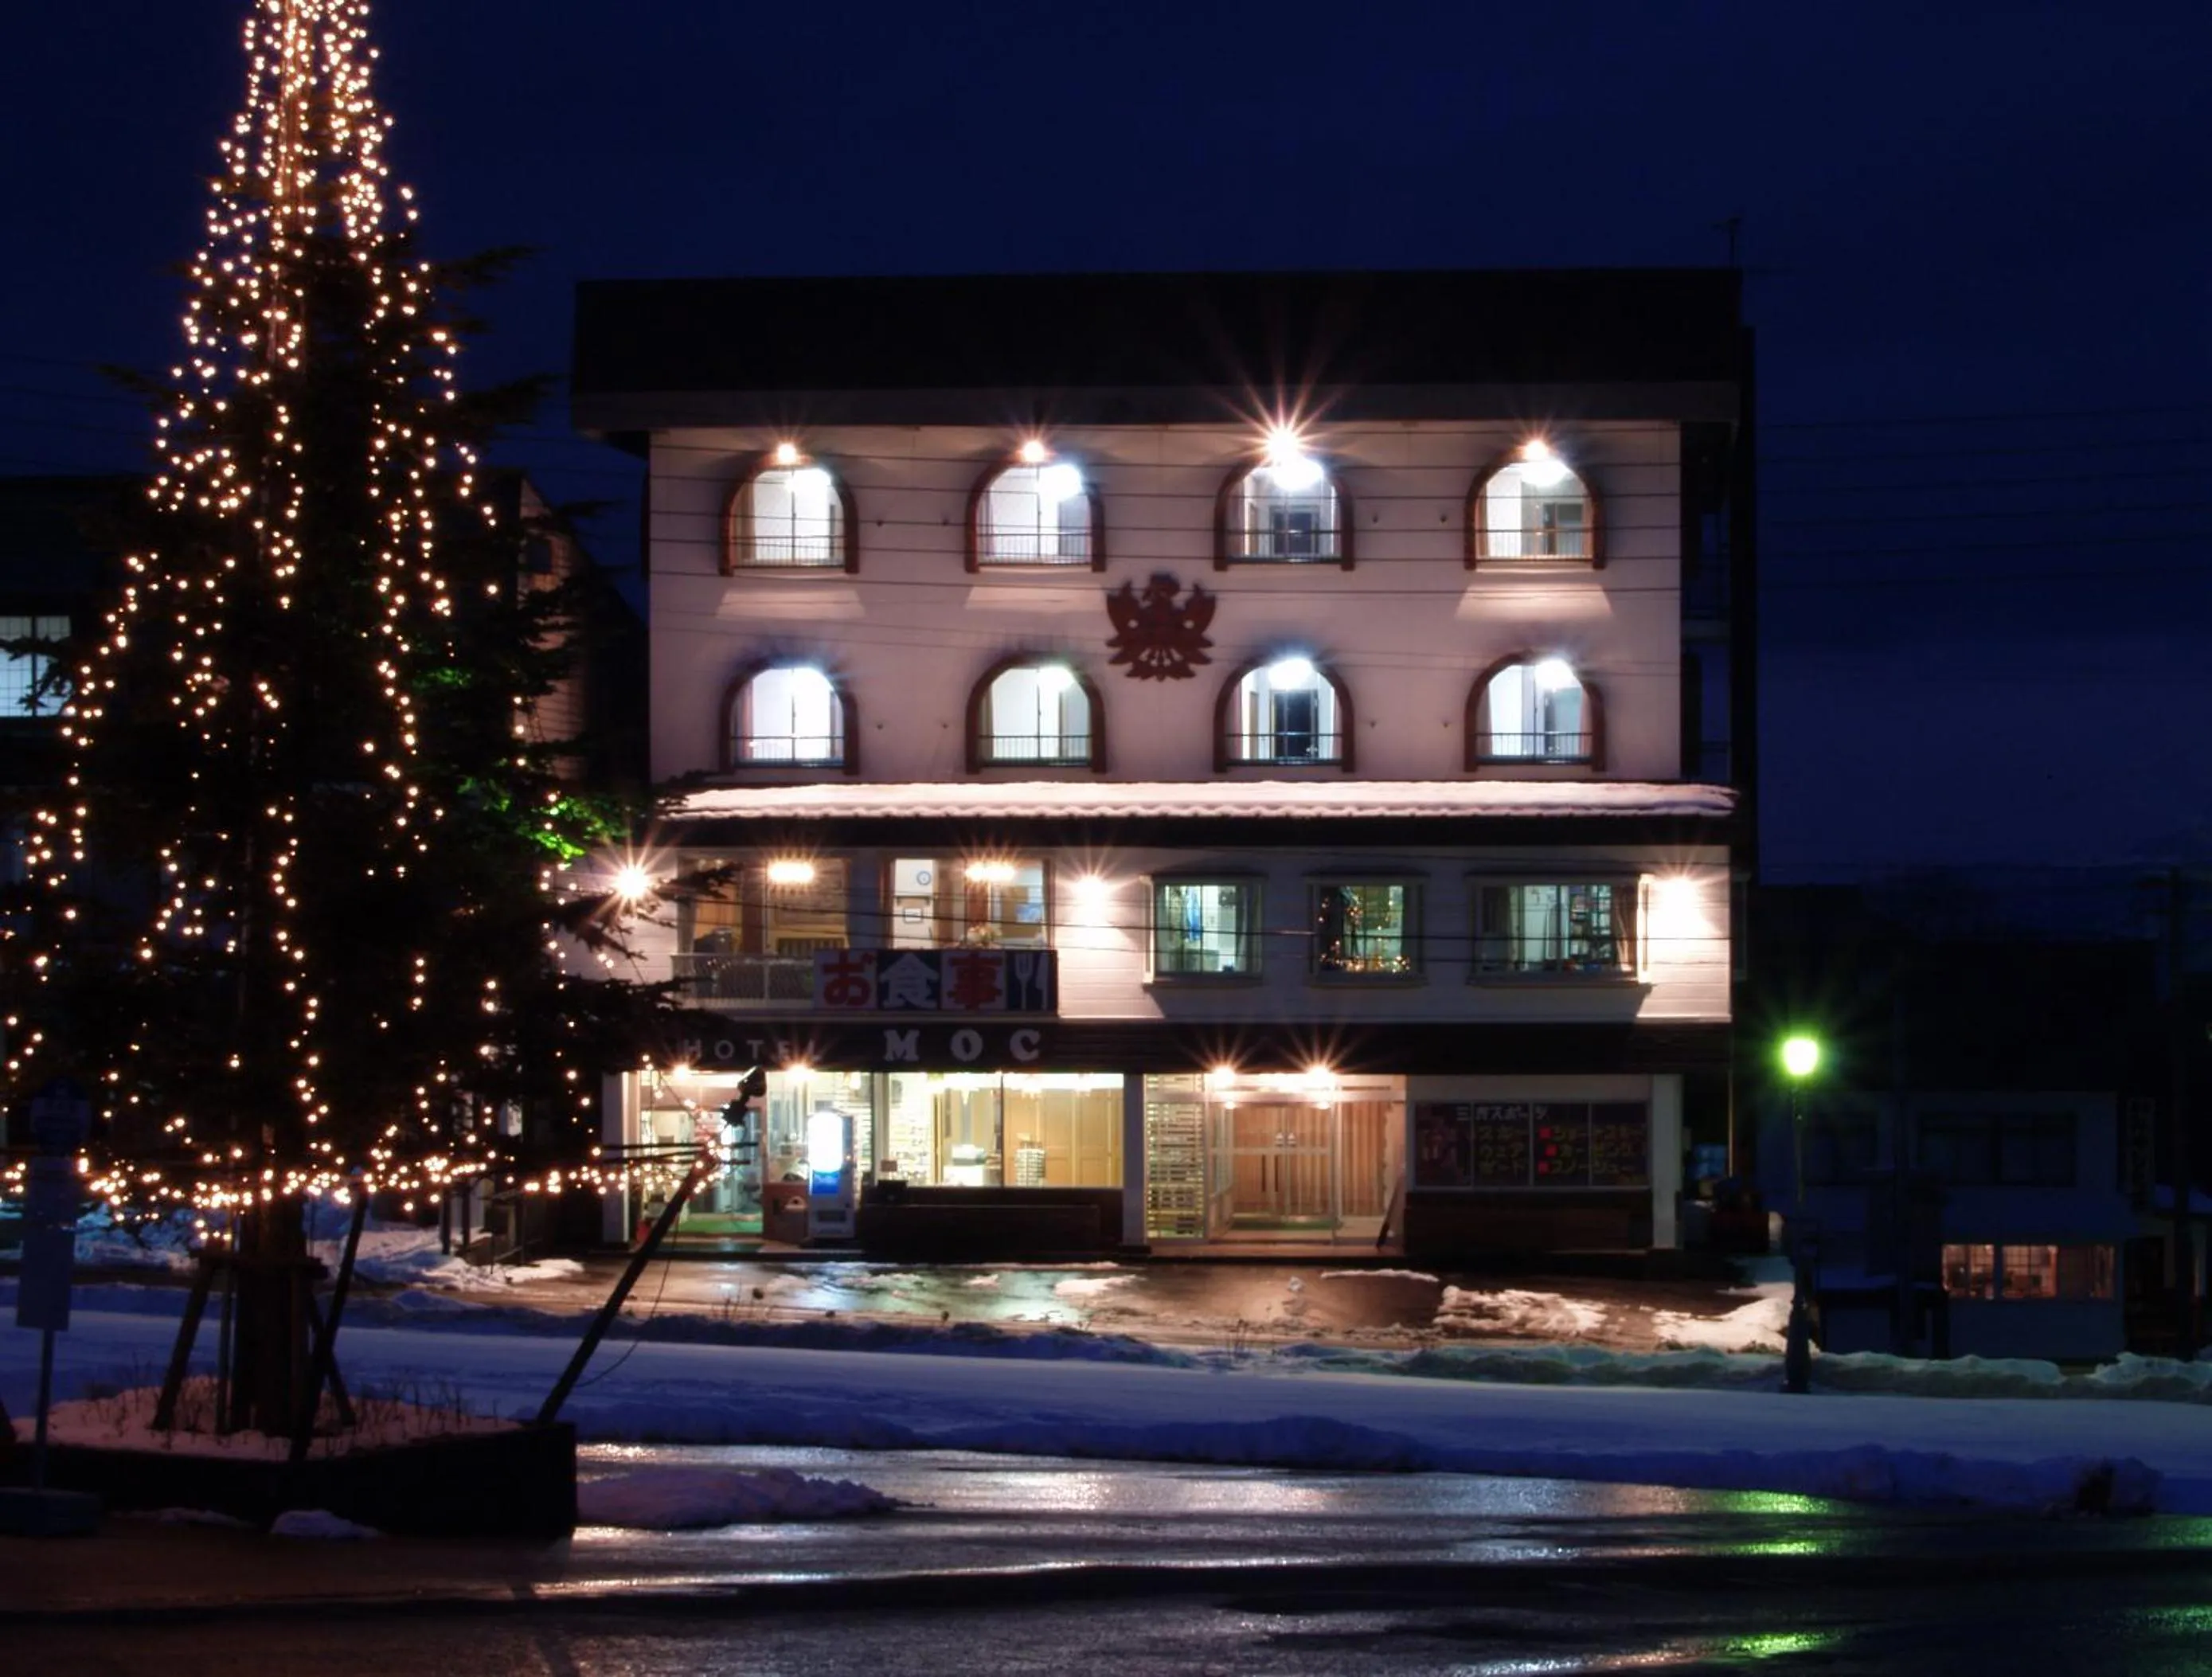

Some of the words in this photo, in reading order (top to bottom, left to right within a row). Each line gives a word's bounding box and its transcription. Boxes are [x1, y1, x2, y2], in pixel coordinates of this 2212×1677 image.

[821, 950, 1002, 1010] お食事
[682, 1038, 823, 1062] HOTEL
[883, 1028, 1042, 1062] MOC
